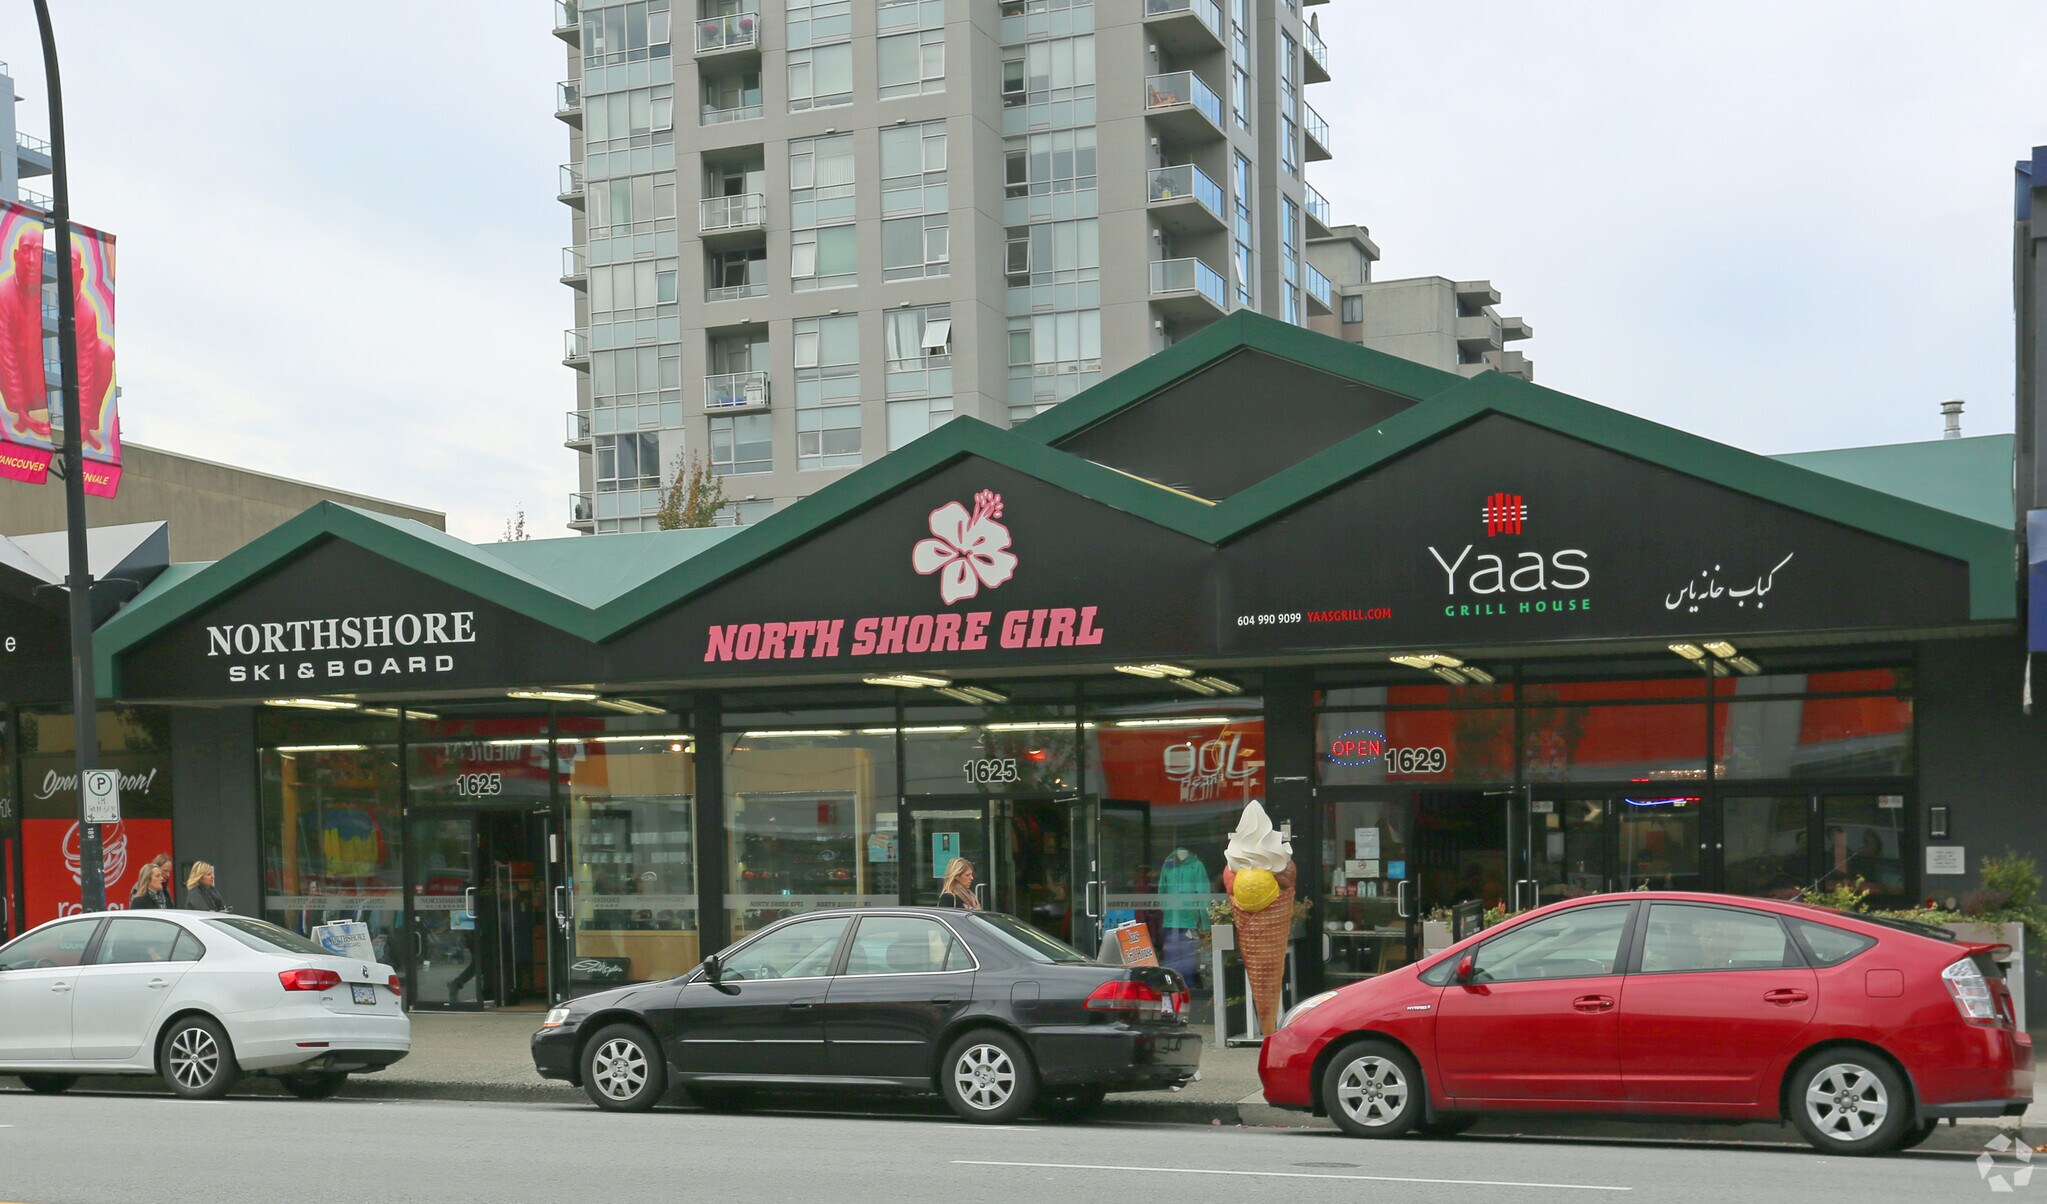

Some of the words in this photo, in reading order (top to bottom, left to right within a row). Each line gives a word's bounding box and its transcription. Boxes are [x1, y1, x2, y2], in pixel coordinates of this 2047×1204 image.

[1427, 544, 1590, 595] Yaas
[1237, 615, 1256, 626] 604
[1258, 614, 1276, 625] 990
[1278, 612, 1302, 624] 9099
[1307, 608, 1392, 622] YAASGRILL.COM
[1445, 603, 1506, 617] GRILL
[1519, 599, 1591, 613] HOUSE
[206, 611, 476, 656] NORTHSHORE
[704, 619, 845, 662] NORTH
[850, 612, 992, 656] SHORE
[1000, 606, 1104, 649] GIRL
[1331, 741, 1381, 756] OPEN
[1384, 747, 1446, 773] 1629
[116, 768, 157, 794] oon!
[963, 758, 1017, 783] 1625
[456, 773, 502, 795] 1625
